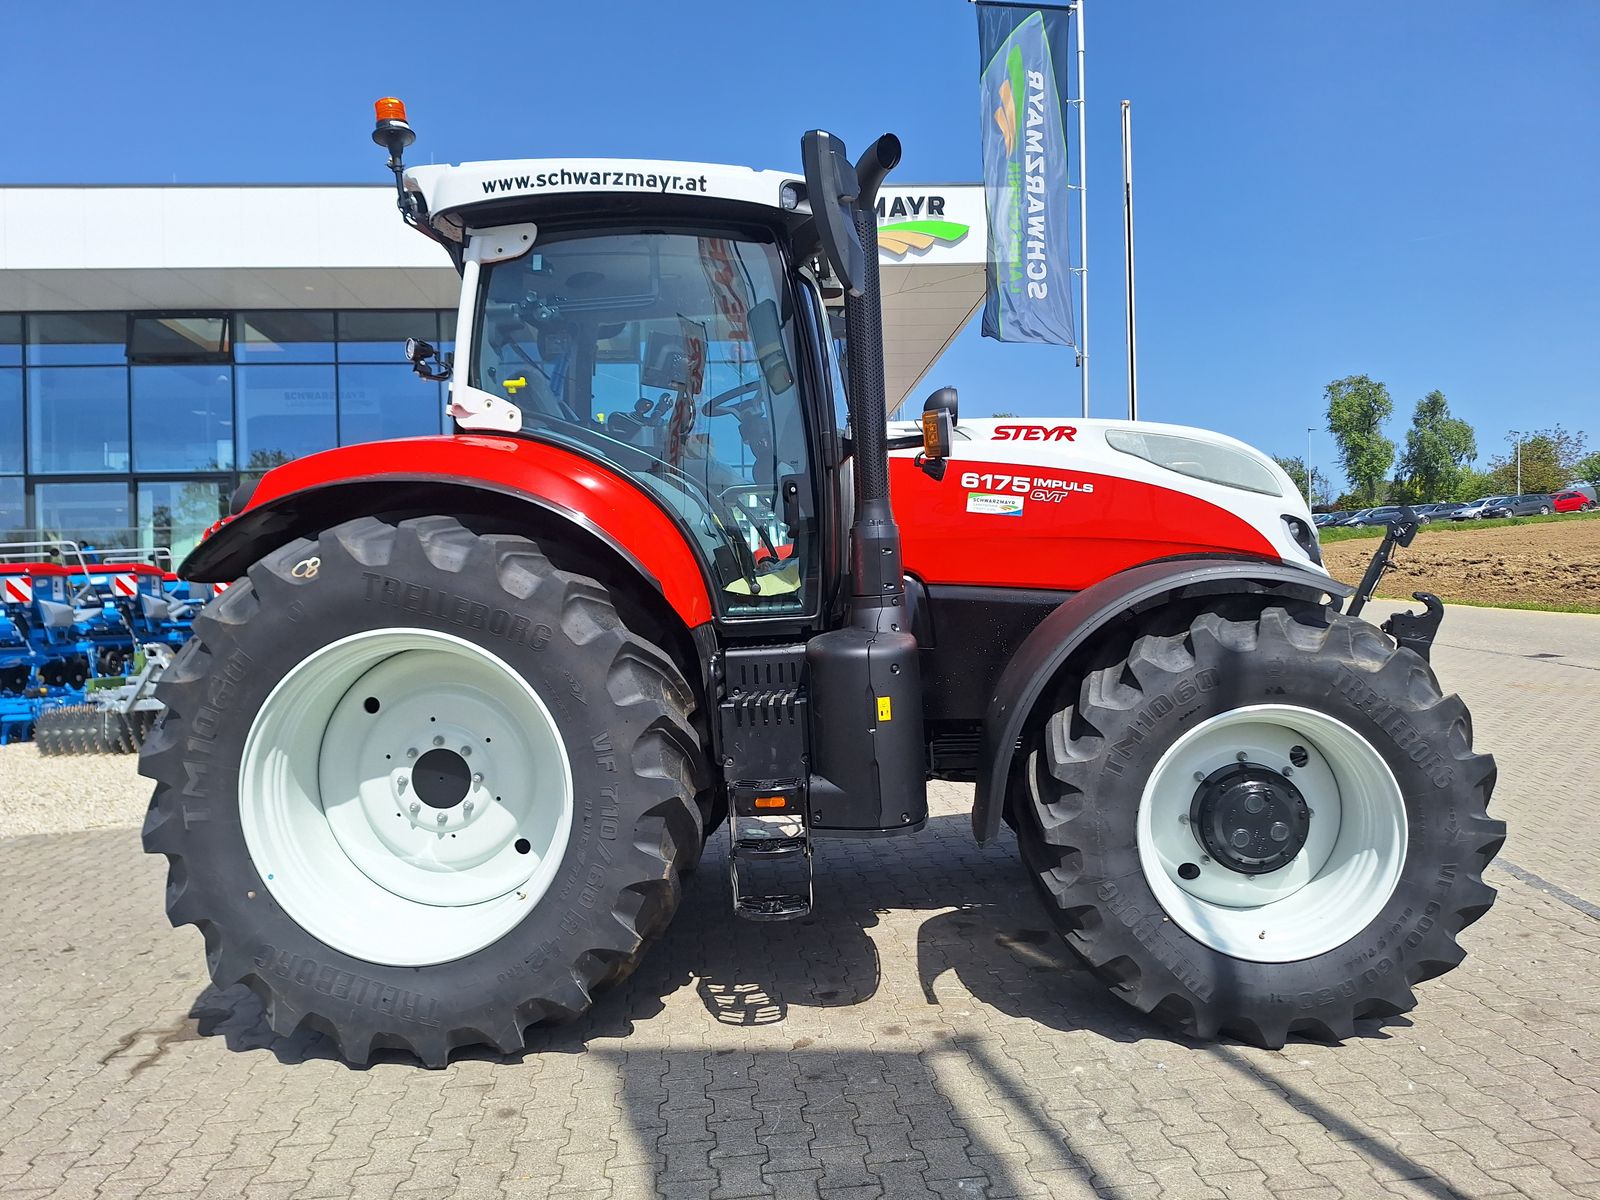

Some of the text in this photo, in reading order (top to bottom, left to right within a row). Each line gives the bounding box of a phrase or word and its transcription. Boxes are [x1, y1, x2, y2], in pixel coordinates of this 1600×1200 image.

[482, 168, 708, 194] www.schwarzmayr.at
[991, 425, 1078, 442] STEYR
[961, 472, 1094, 493] 6175 IMPULS
[1029, 489, 1068, 503] CVT
[361, 570, 553, 651] TRELLEBORG
[1099, 667, 1220, 778] TM1060
